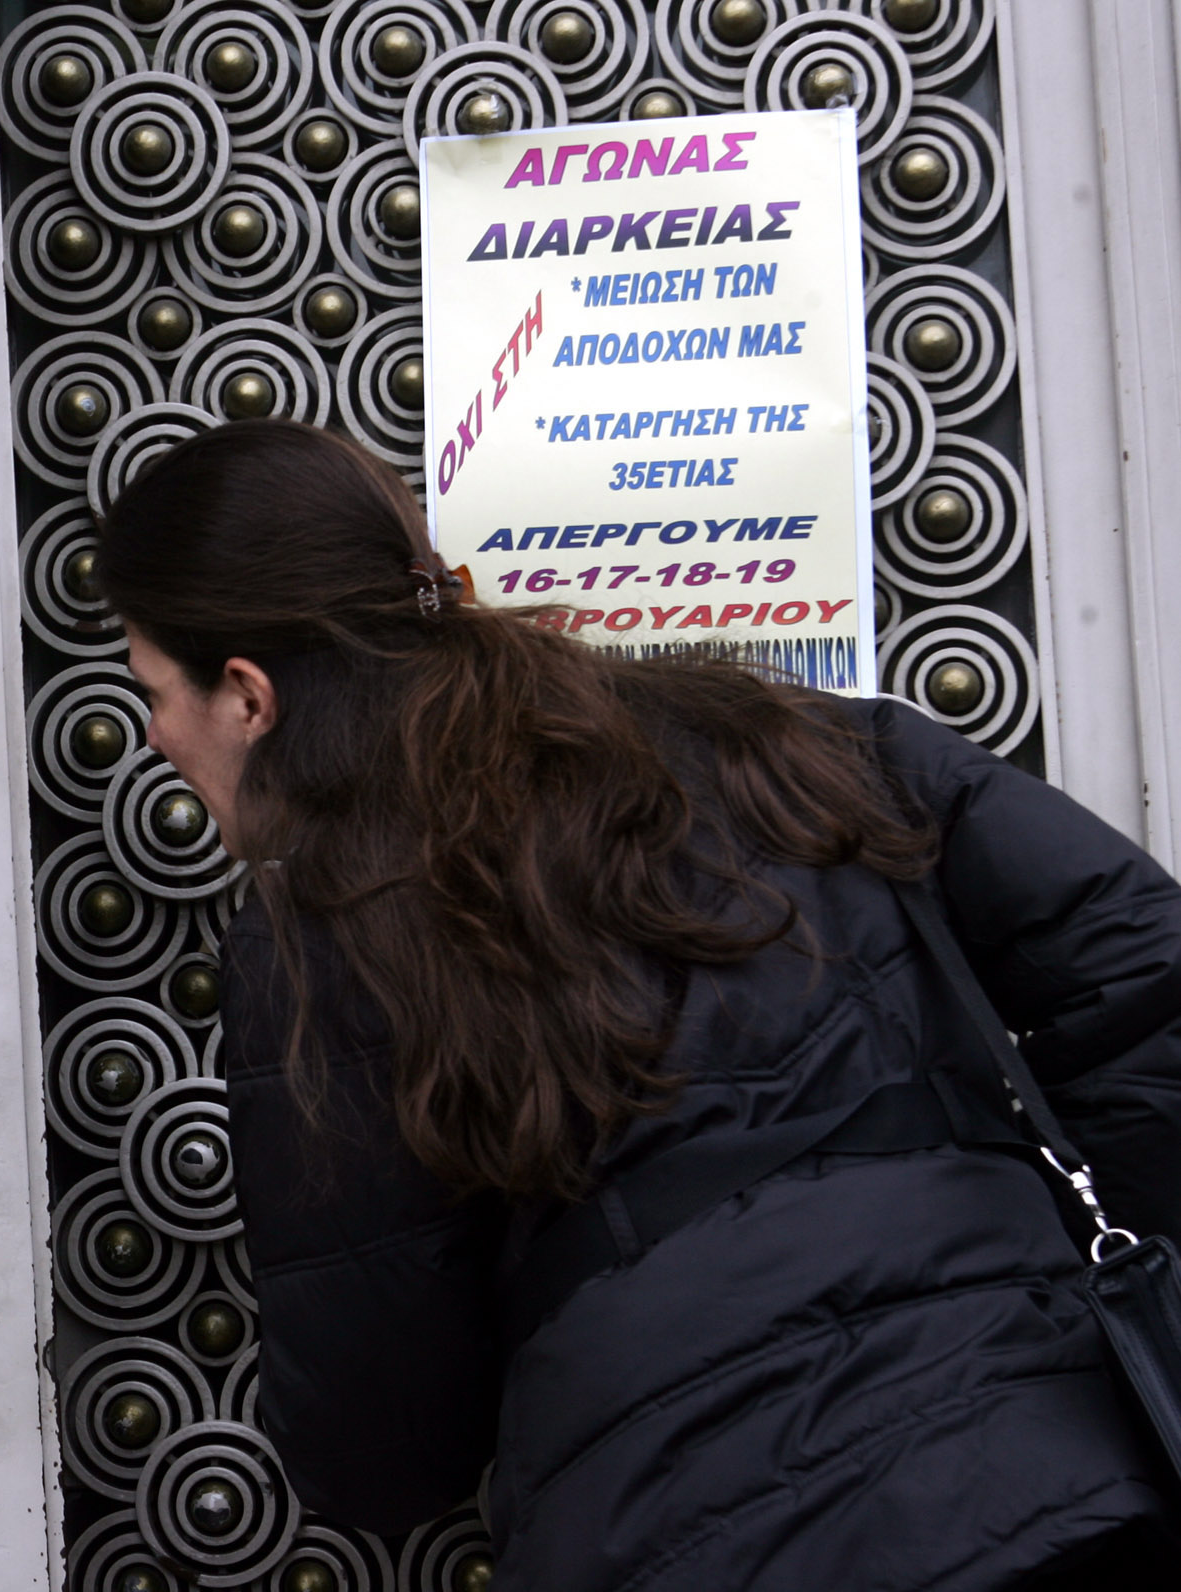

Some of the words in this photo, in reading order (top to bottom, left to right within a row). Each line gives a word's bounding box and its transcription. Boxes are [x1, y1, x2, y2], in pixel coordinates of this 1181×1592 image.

[503, 131, 757, 189] ΑΓΩΝΑΣ
[466, 200, 801, 262] ΔΙΑΡΚΕΙΑΣ
[714, 262, 778, 299] ΤΩΝ
[552, 326, 731, 368] ΑΠΟΔΟΧΩΝ
[738, 321, 806, 358] ΜΑΣ
[438, 388, 483, 496] ΟΧΙ
[491, 288, 543, 412] ΣΤΗ
[747, 403, 810, 434] ΤΗΣ
[608, 457, 739, 491] 35ΕΤΙΑΣ
[476, 515, 819, 552] ΑΠΕΡΓΟΥΜΕ
[497, 558, 797, 594] 16-17-18-19
[516, 599, 854, 634] ΒΡΟΥΑΡΙΟΥ
